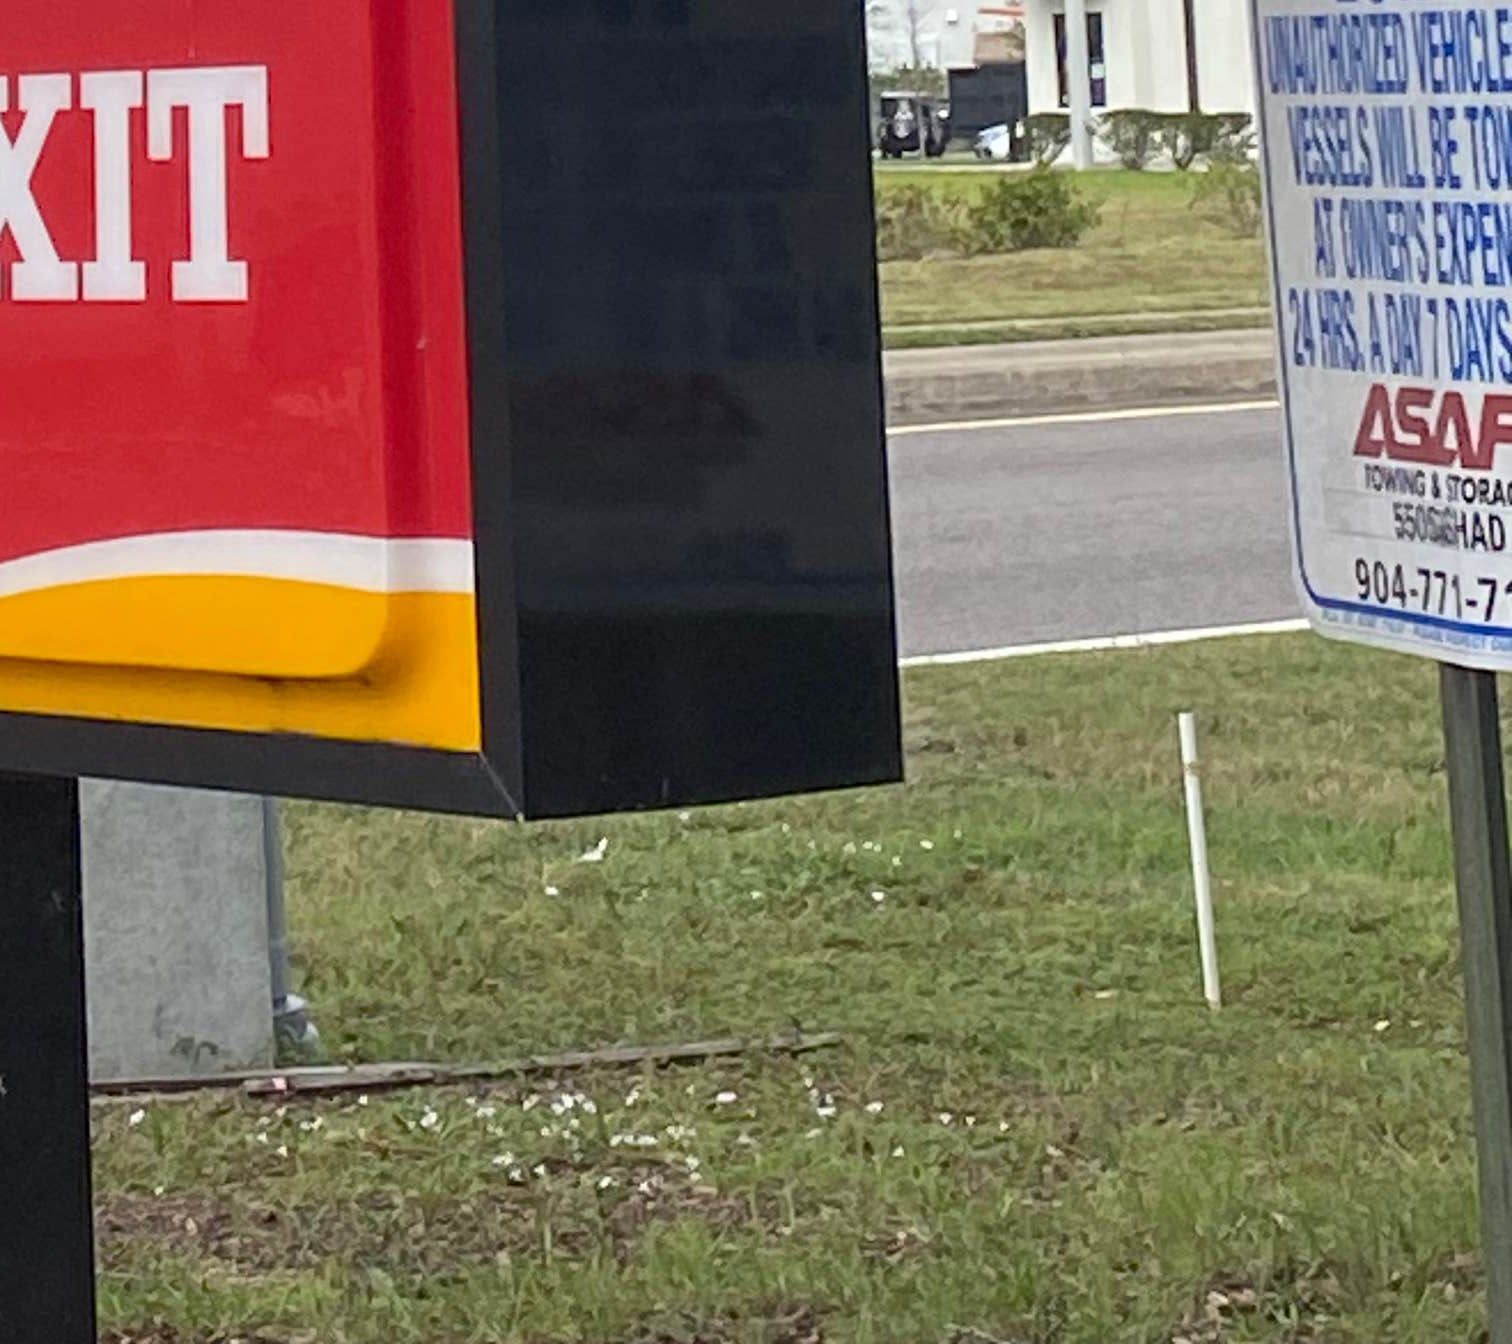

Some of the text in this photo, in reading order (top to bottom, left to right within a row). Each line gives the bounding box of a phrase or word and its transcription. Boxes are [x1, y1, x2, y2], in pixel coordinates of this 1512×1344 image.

[1264, 13, 1409, 94] UNAUTHORIZED
[1287, 105, 1373, 188] VESSELS
[1373, 105, 1426, 188] WILL
[1428, 105, 1462, 190] BE
[1314, 197, 1336, 278] AT
[1289, 287, 1316, 367] 24
[1368, 291, 1386, 374] A
[1384, 293, 1423, 378] DAY
[1426, 298, 1439, 380] 7
[1445, 297, 1512, 384] DAYS
[1364, 464, 1426, 497] TOWING
